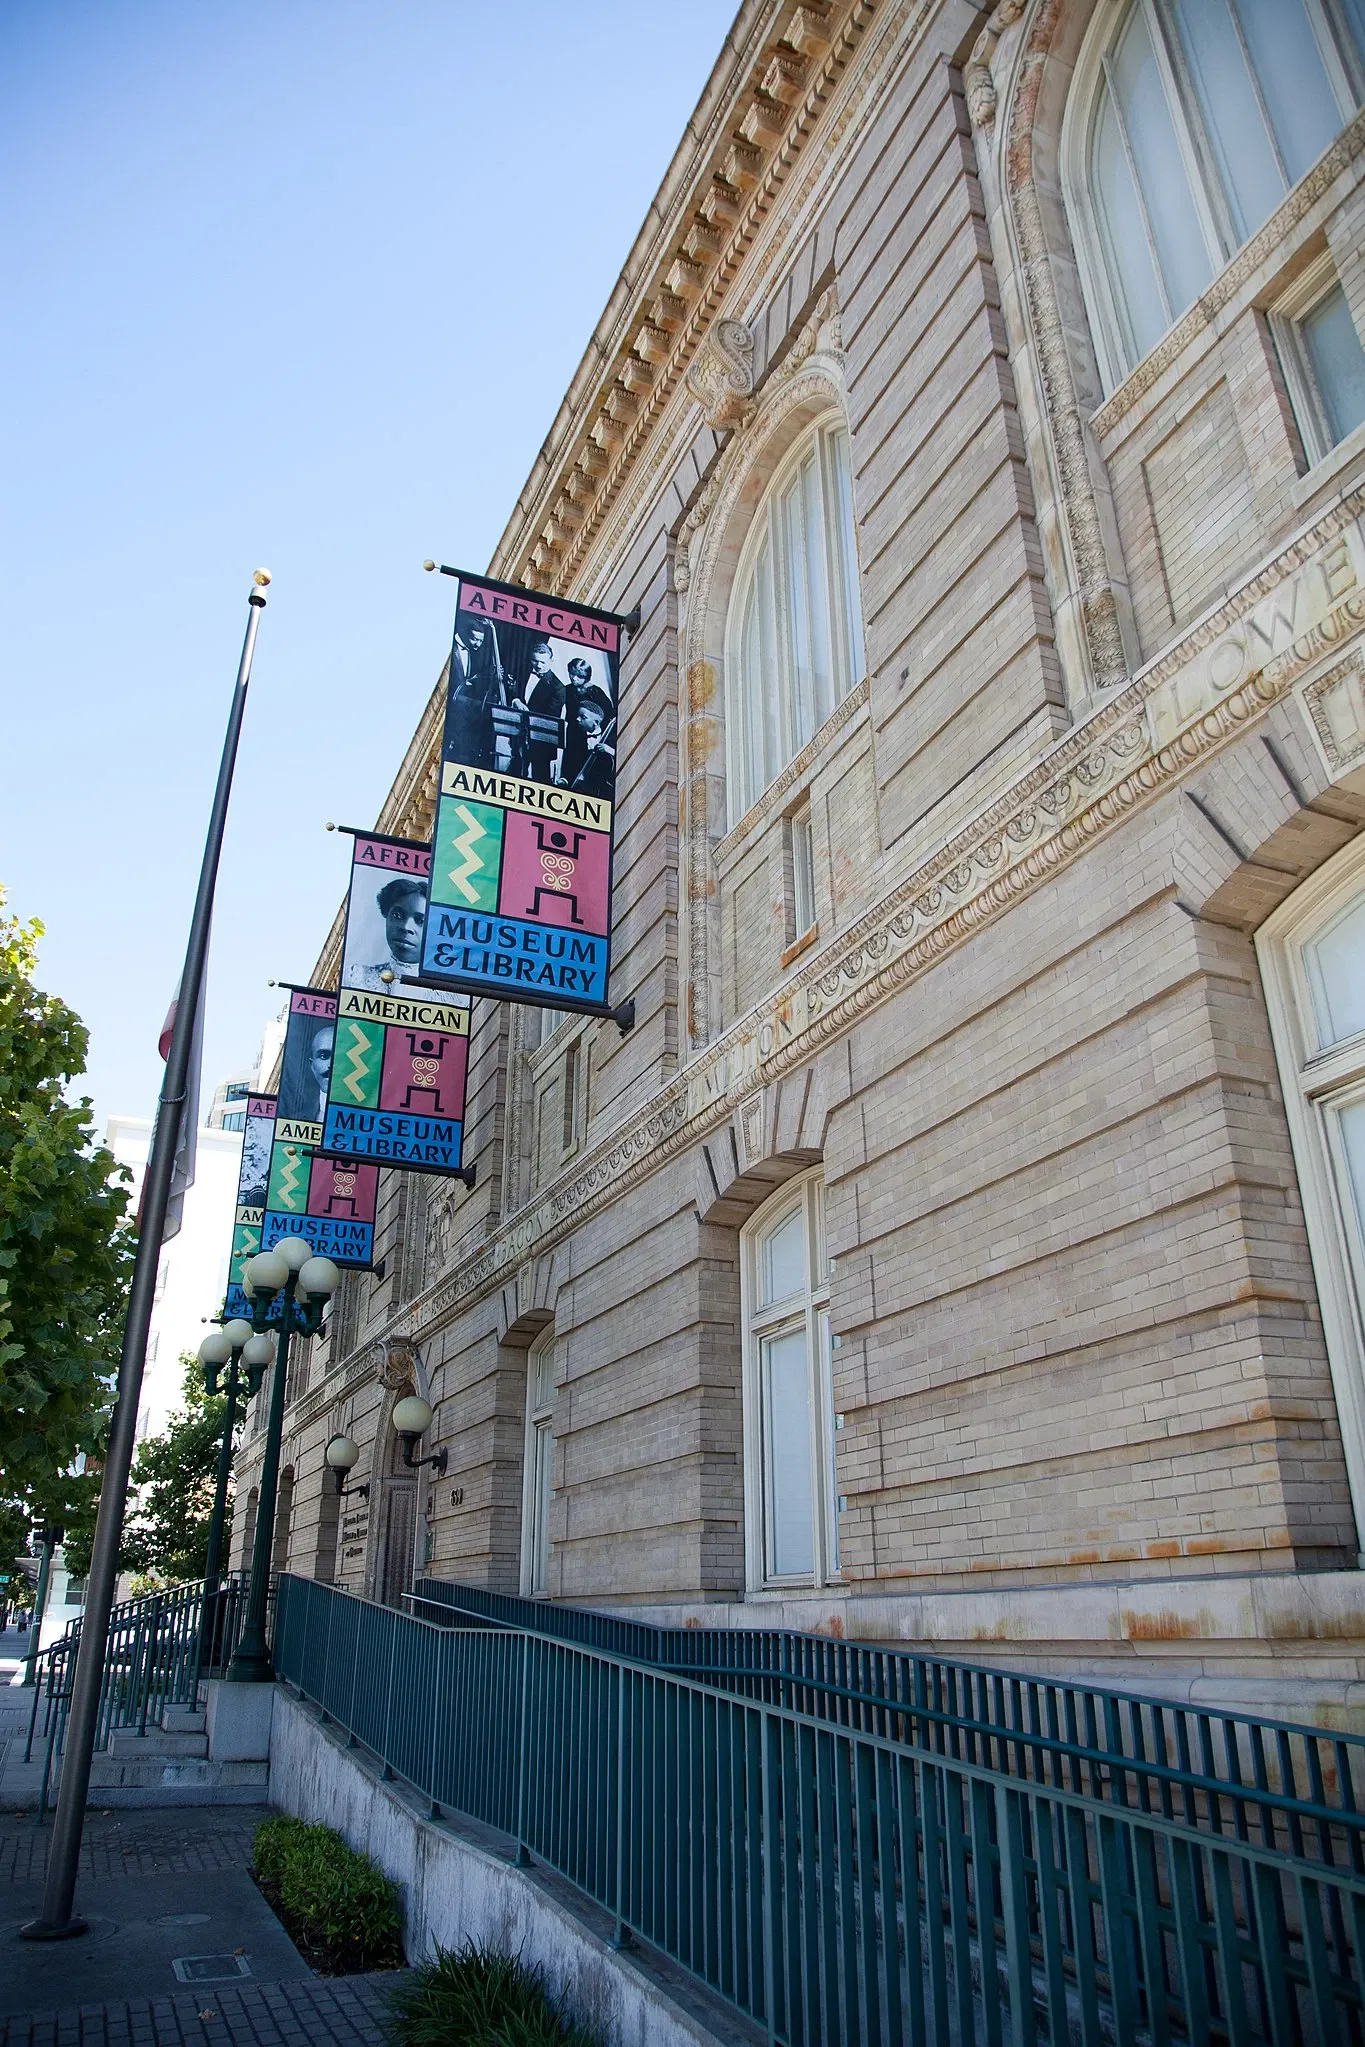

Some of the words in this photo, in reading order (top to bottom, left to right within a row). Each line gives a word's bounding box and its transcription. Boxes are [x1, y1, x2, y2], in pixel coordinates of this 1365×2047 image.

[467, 591, 610, 645] AFRICAN
[450, 770, 602, 824] AMERICAN
[438, 913, 598, 965] MUSEUM
[344, 995, 462, 1030] AMERICAN
[334, 1112, 454, 1144] MUSEUM
[270, 1216, 366, 1241] MUSEUM
